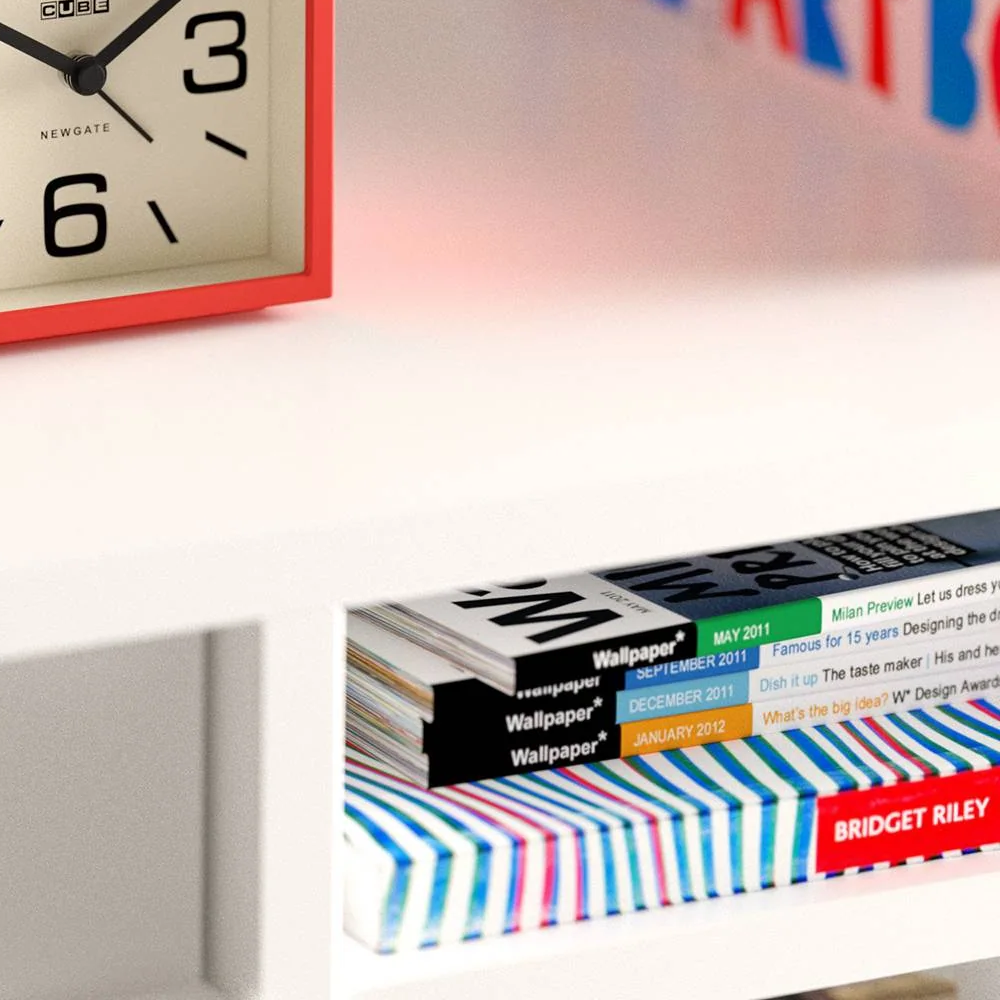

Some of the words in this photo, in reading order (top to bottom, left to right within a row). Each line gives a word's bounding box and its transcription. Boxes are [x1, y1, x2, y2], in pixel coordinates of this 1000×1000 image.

[183, 10, 248, 94] 3
[40, 122, 112, 141] NEWGATE
[43, 173, 108, 257] 6
[831, 608, 863, 622] Milan
[867, 596, 914, 616] Preview
[917, 591, 936, 606] Let
[938, 590, 953, 601] us
[955, 579, 988, 598] dress
[713, 628, 740, 646] MAY
[743, 622, 770, 640] 2011
[772, 638, 822, 658] Famous
[826, 633, 842, 648] for
[847, 631, 862, 645] 15
[865, 627, 899, 645] years
[903, 615, 964, 636] Designing
[967, 611, 987, 625] the
[636, 656, 715, 680] SEPTEMBER
[718, 650, 747, 665] 2011
[760, 676, 788, 693] Dish
[791, 674, 801, 688] it
[803, 673, 818, 688] up
[822, 667, 846, 683] The
[850, 664, 881, 679] taste
[884, 655, 923, 673] maker
[934, 649, 955, 664] His
[958, 644, 981, 661] and
[629, 691, 702, 714] DECEMBER
[705, 684, 734, 701] 2011
[763, 707, 806, 726] What's
[808, 703, 829, 718] the
[832, 700, 851, 716] big
[854, 693, 889, 710] idea?
[915, 681, 957, 701] Design
[633, 723, 694, 747] JANUARY
[696, 719, 726, 737] 2012
[834, 807, 928, 843] BRIDGET
[932, 797, 990, 826] RILEY
